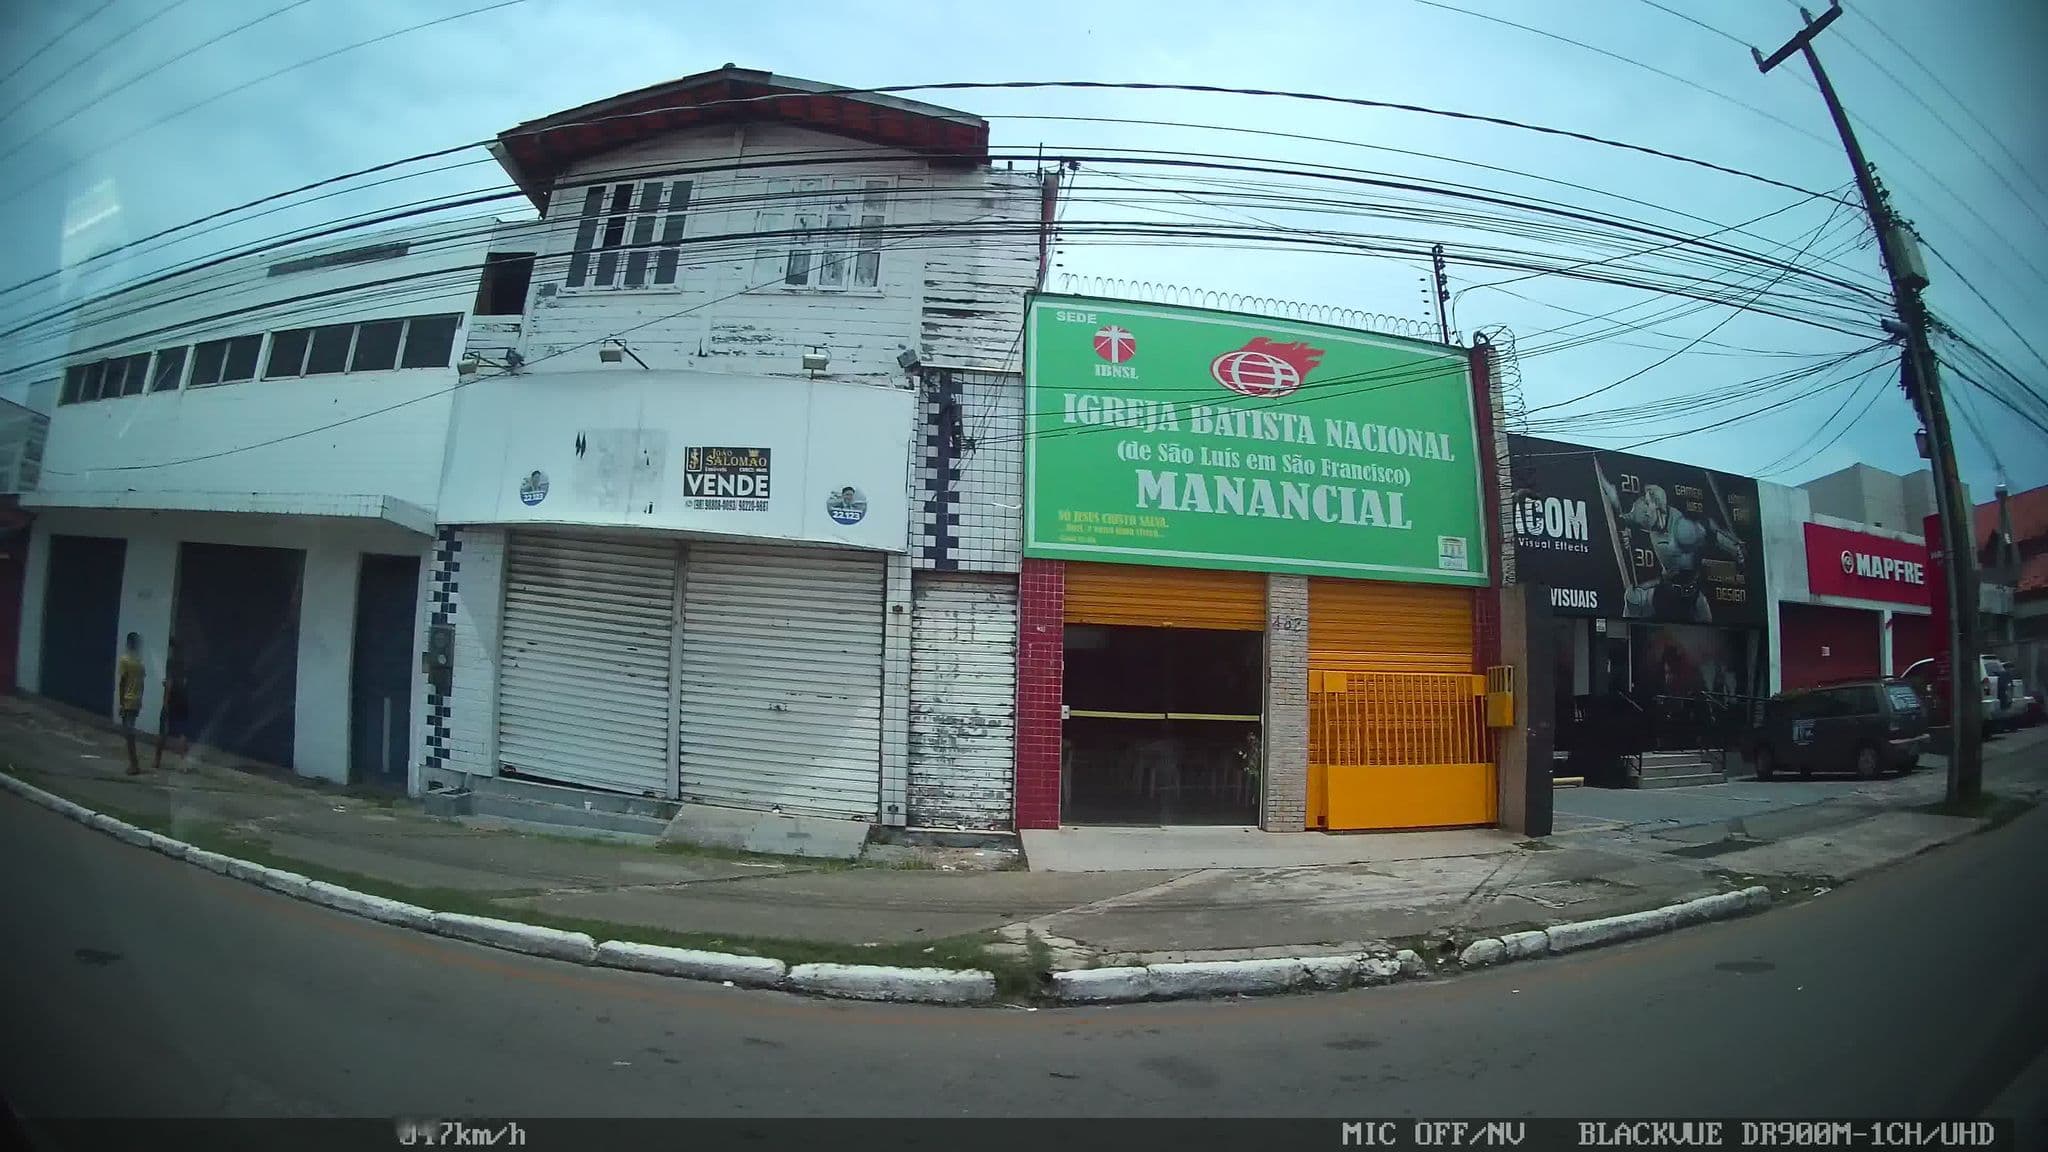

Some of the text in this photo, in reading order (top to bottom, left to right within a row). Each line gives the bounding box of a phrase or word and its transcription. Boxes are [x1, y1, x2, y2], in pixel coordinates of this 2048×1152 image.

[1056, 311, 1097, 324] SEDE
[1095, 364, 1139, 379] IBNSL
[1063, 393, 1455, 462] IGREJA BATISTA NACIONAL
[1117, 440, 1411, 487] (de São Luís em São Francisco)
[686, 473, 769, 496] VENDE
[1136, 469, 1412, 530] MANANCIAL
[1518, 537, 1589, 553] Visual Effects
[1856, 553, 1925, 585] MAPFRE
[1550, 587, 1598, 608] VISUAIS
